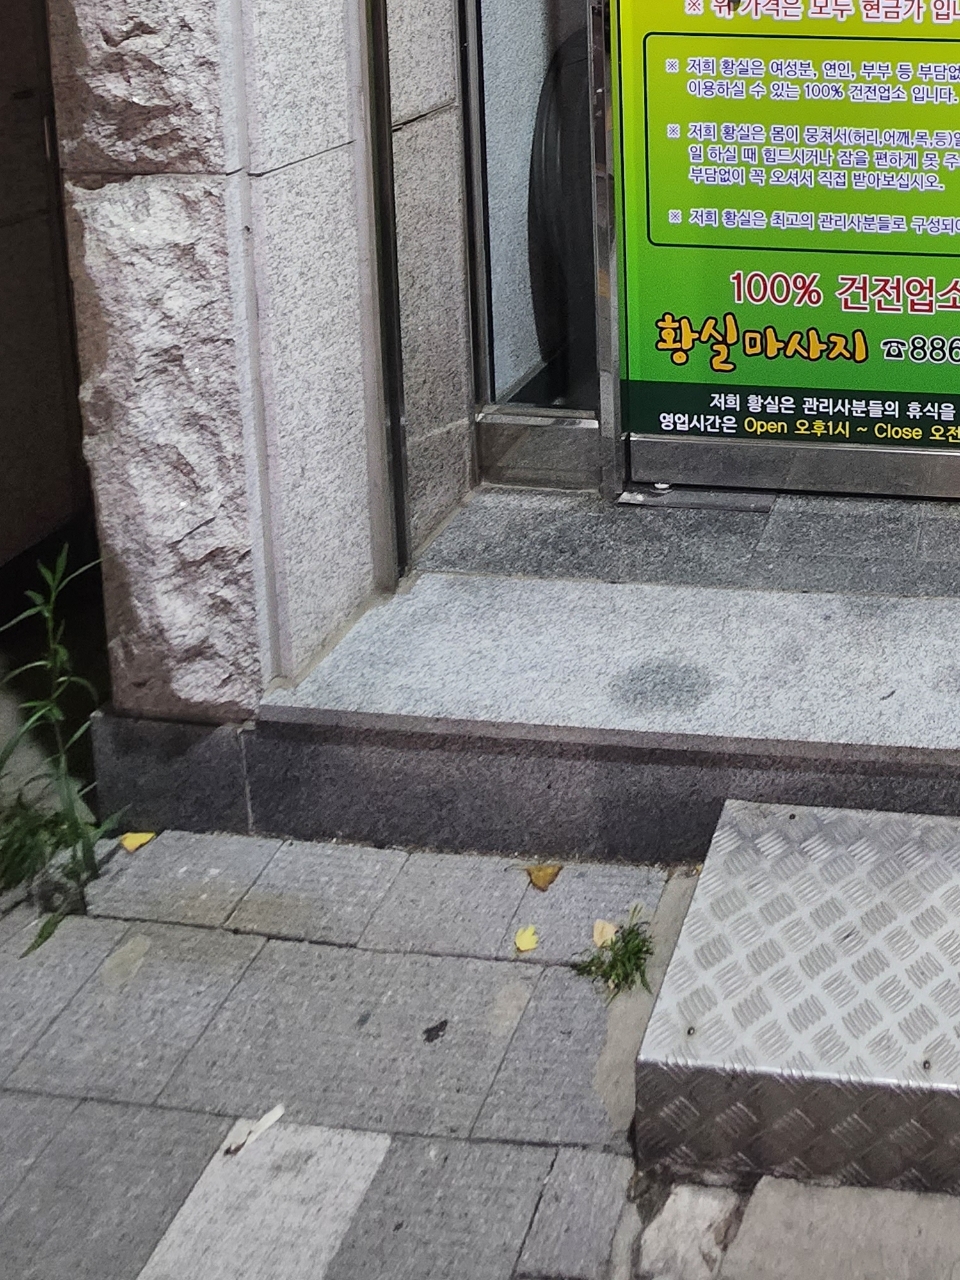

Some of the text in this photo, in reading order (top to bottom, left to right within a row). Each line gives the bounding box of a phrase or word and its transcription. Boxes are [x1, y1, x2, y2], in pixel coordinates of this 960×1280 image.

[687, 58, 716, 75] 저희
[720, 59, 765, 76] 황실은
[769, 60, 818, 78] 여성분,
[823, 61, 856, 79] 연인,
[861, 63, 892, 79] 부부
[896, 63, 913, 80] 등
[688, 79, 959, 103] 이용하실 수 있는 100% 건전업소 입니다.
[688, 123, 717, 140] 저희
[721, 124, 766, 141] 황실은
[770, 125, 800, 143] 몸이
[689, 145, 703, 162] 일
[708, 145, 737, 163] 하실
[742, 146, 758, 164] 때
[762, 147, 834, 165] 힘드시거나
[837, 149, 869, 166] 잠을
[874, 151, 918, 168] 편하게
[922, 152, 939, 169] 못
[689, 167, 945, 190] 부담없이 꼭 오셔서 직접 받아보십시오.
[690, 209, 718, 226] 저희
[723, 210, 767, 227] 황실은
[771, 211, 814, 229] 최고의
[819, 213, 907, 232] 관리사분들로
[731, 271, 823, 306] 100%
[709, 392, 741, 412] 저희
[746, 394, 797, 414] 황실은
[802, 397, 900, 419] 관리사분들의
[905, 401, 956, 421] 휴식을
[658, 412, 738, 433] 영업시간은
[743, 417, 788, 436] Open
[793, 419, 850, 439] 오후1시
[873, 422, 923, 440] Close
